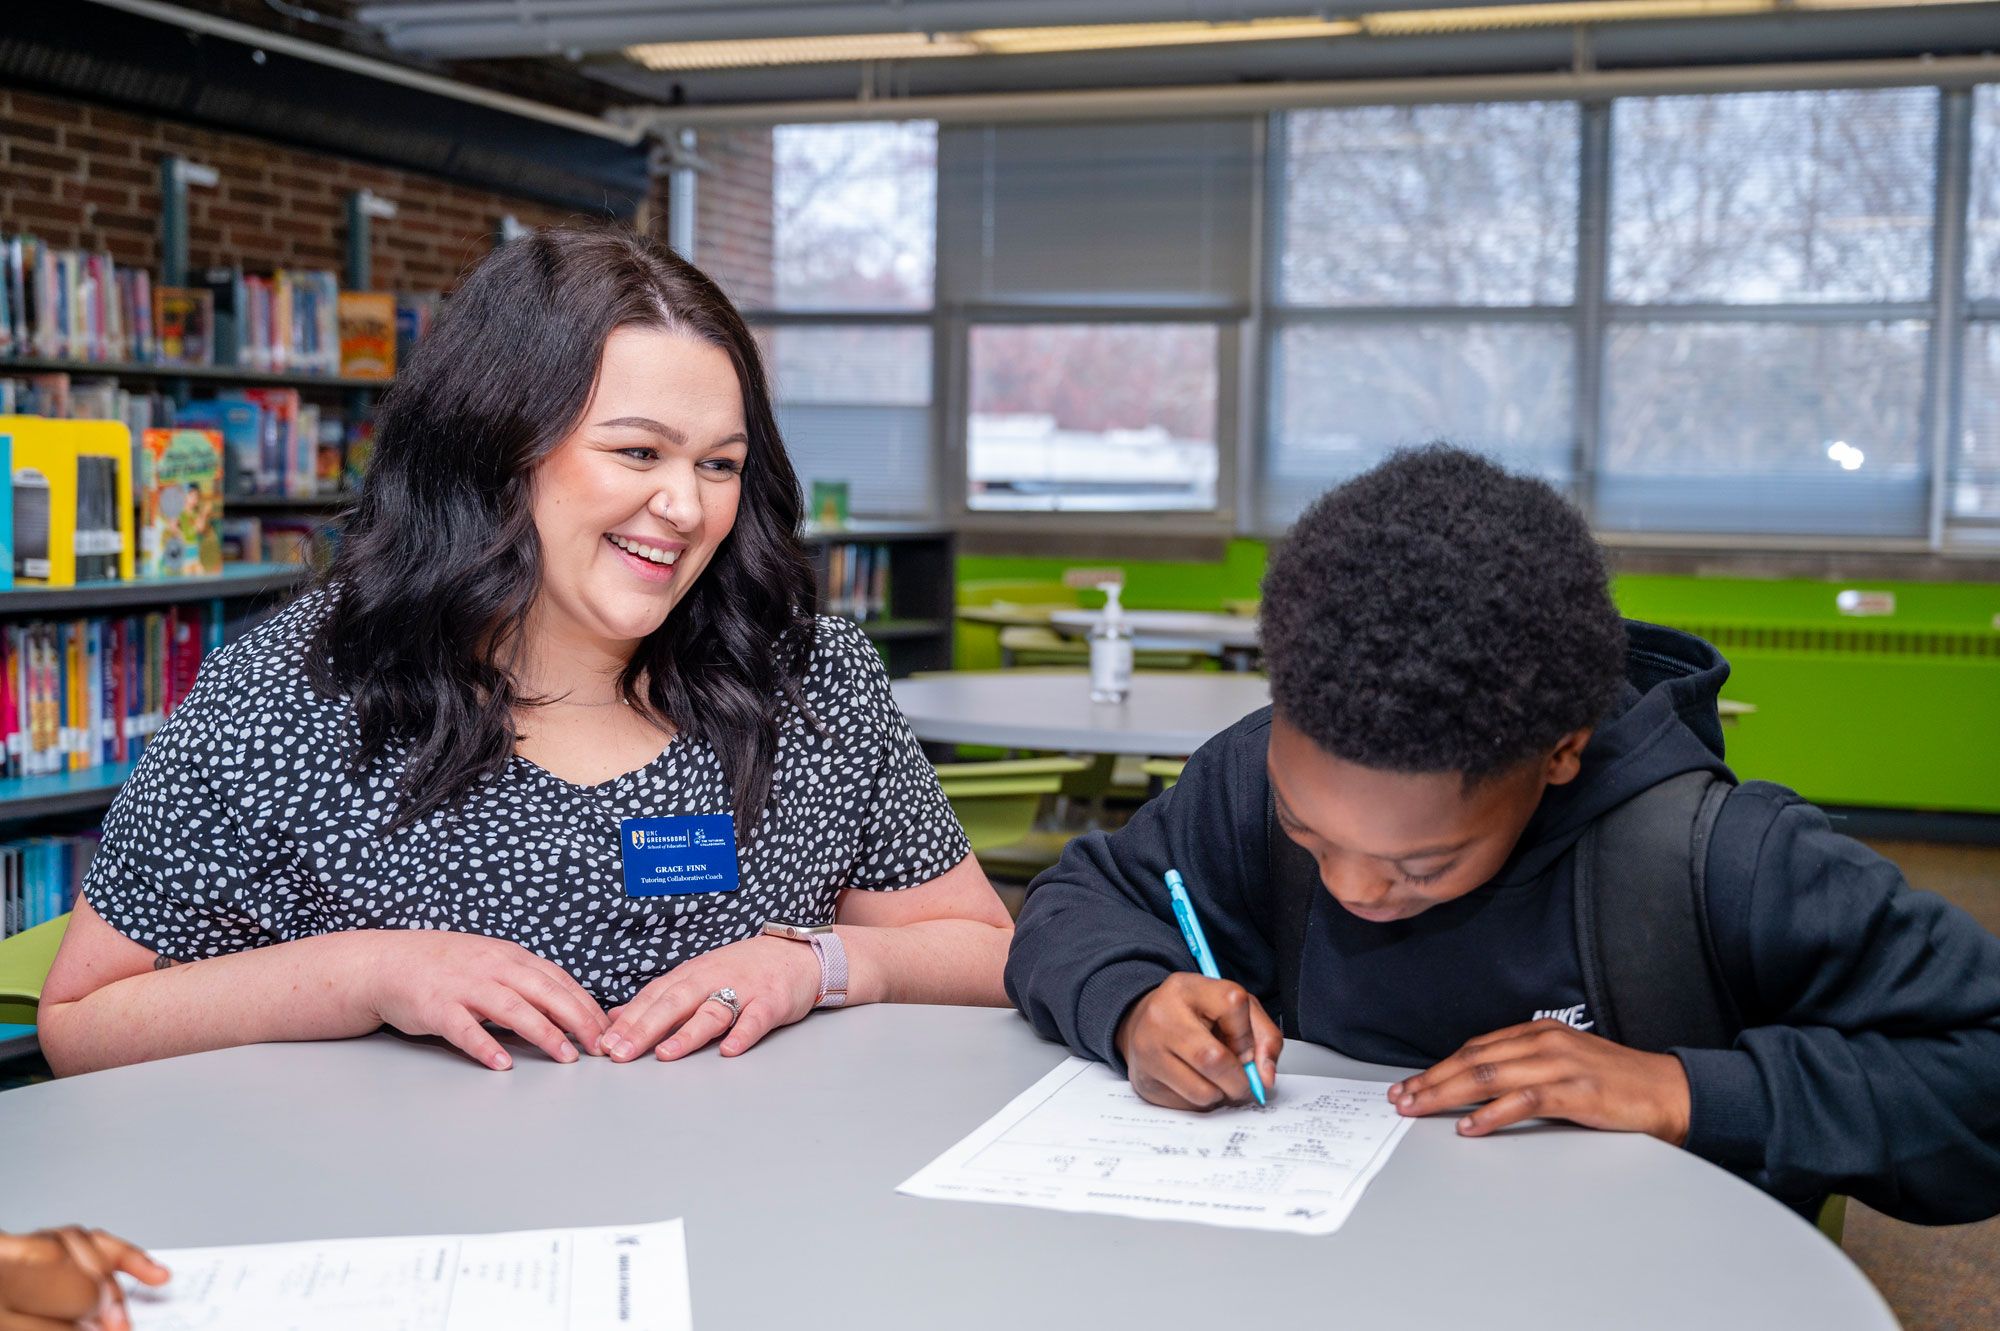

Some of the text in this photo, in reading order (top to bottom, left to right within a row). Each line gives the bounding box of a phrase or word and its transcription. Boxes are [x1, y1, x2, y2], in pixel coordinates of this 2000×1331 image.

[646, 835, 687, 843] GREENSBORO
[655, 864, 707, 873] GRACE FINN
[641, 876, 666, 884] Tutoring
[667, 874, 704, 882] Collaborative
